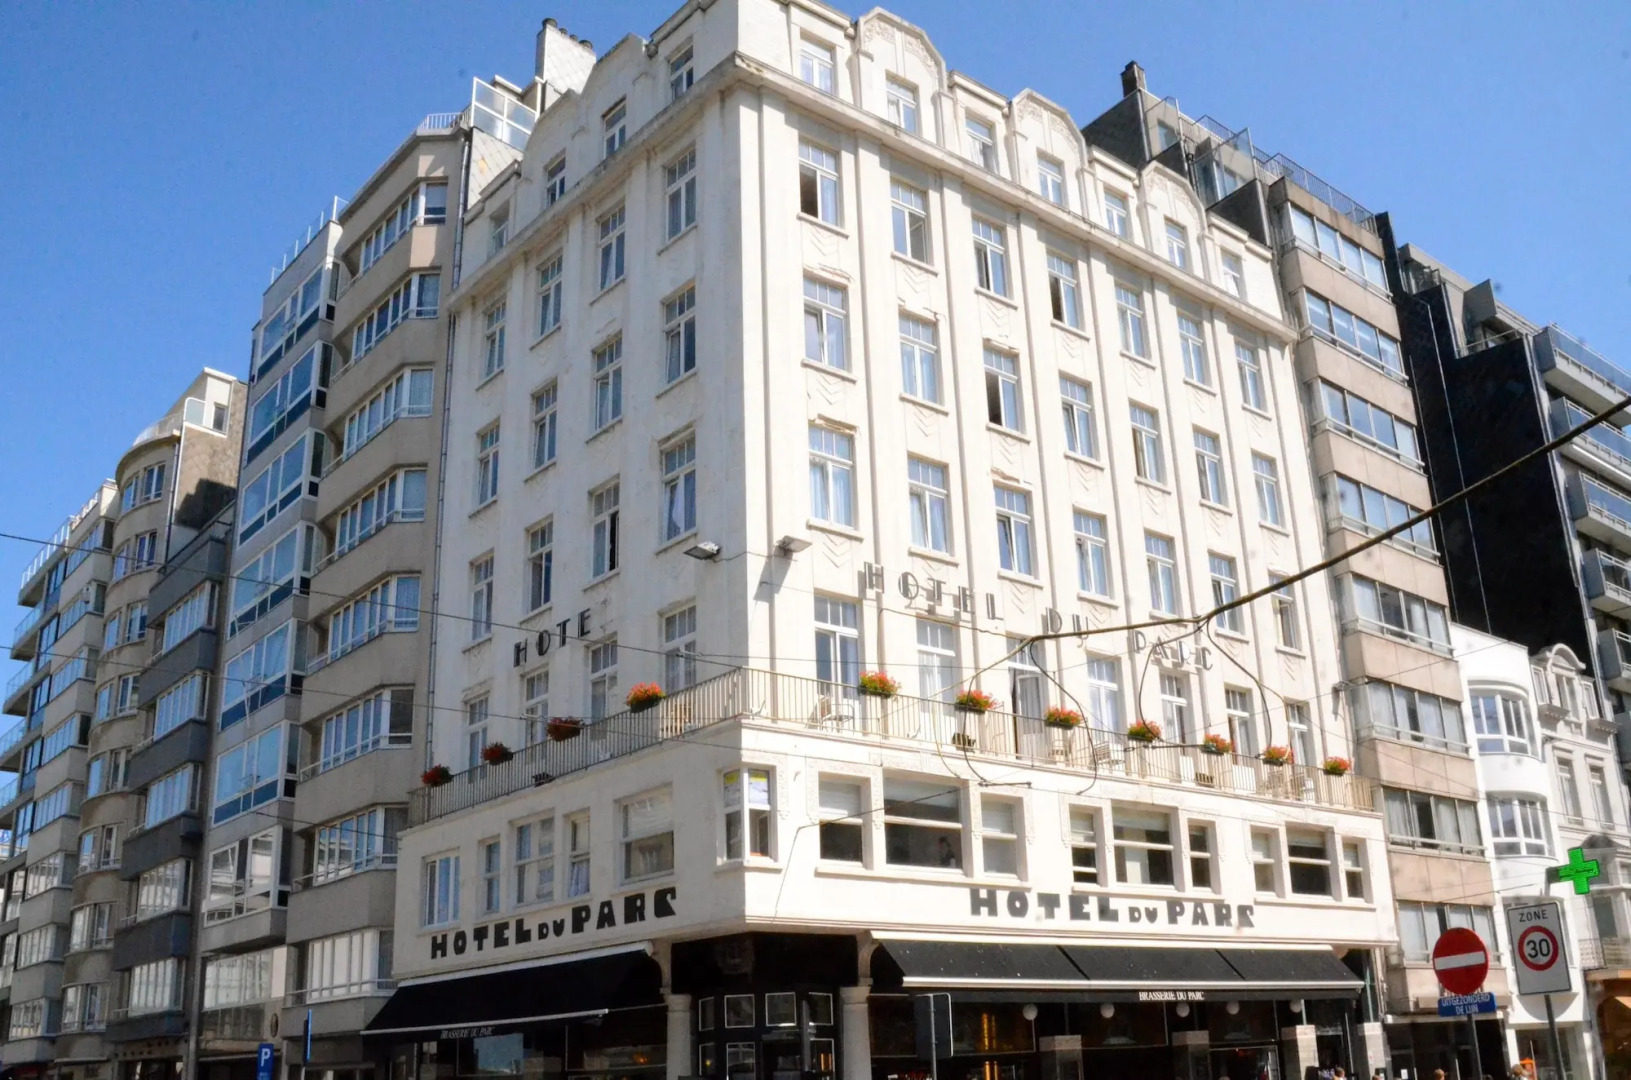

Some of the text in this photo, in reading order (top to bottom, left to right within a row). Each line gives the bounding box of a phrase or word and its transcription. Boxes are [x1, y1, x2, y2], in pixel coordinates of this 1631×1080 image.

[864, 561, 1004, 621] HOTEL
[1046, 607, 1089, 641] DU
[969, 887, 1255, 928] HOTEL DU PARC
[1518, 909, 1548, 923] ZONE
[430, 886, 677, 960] HOTEL DU PARC
[1526, 938, 1551, 959] 30
[1138, 990, 1205, 1001] BRASSERIE DU PARC
[1441, 993, 1490, 1007] UITGEZONDERD
[1455, 1005, 1465, 1015] DE
[261, 1047, 271, 1067] P
